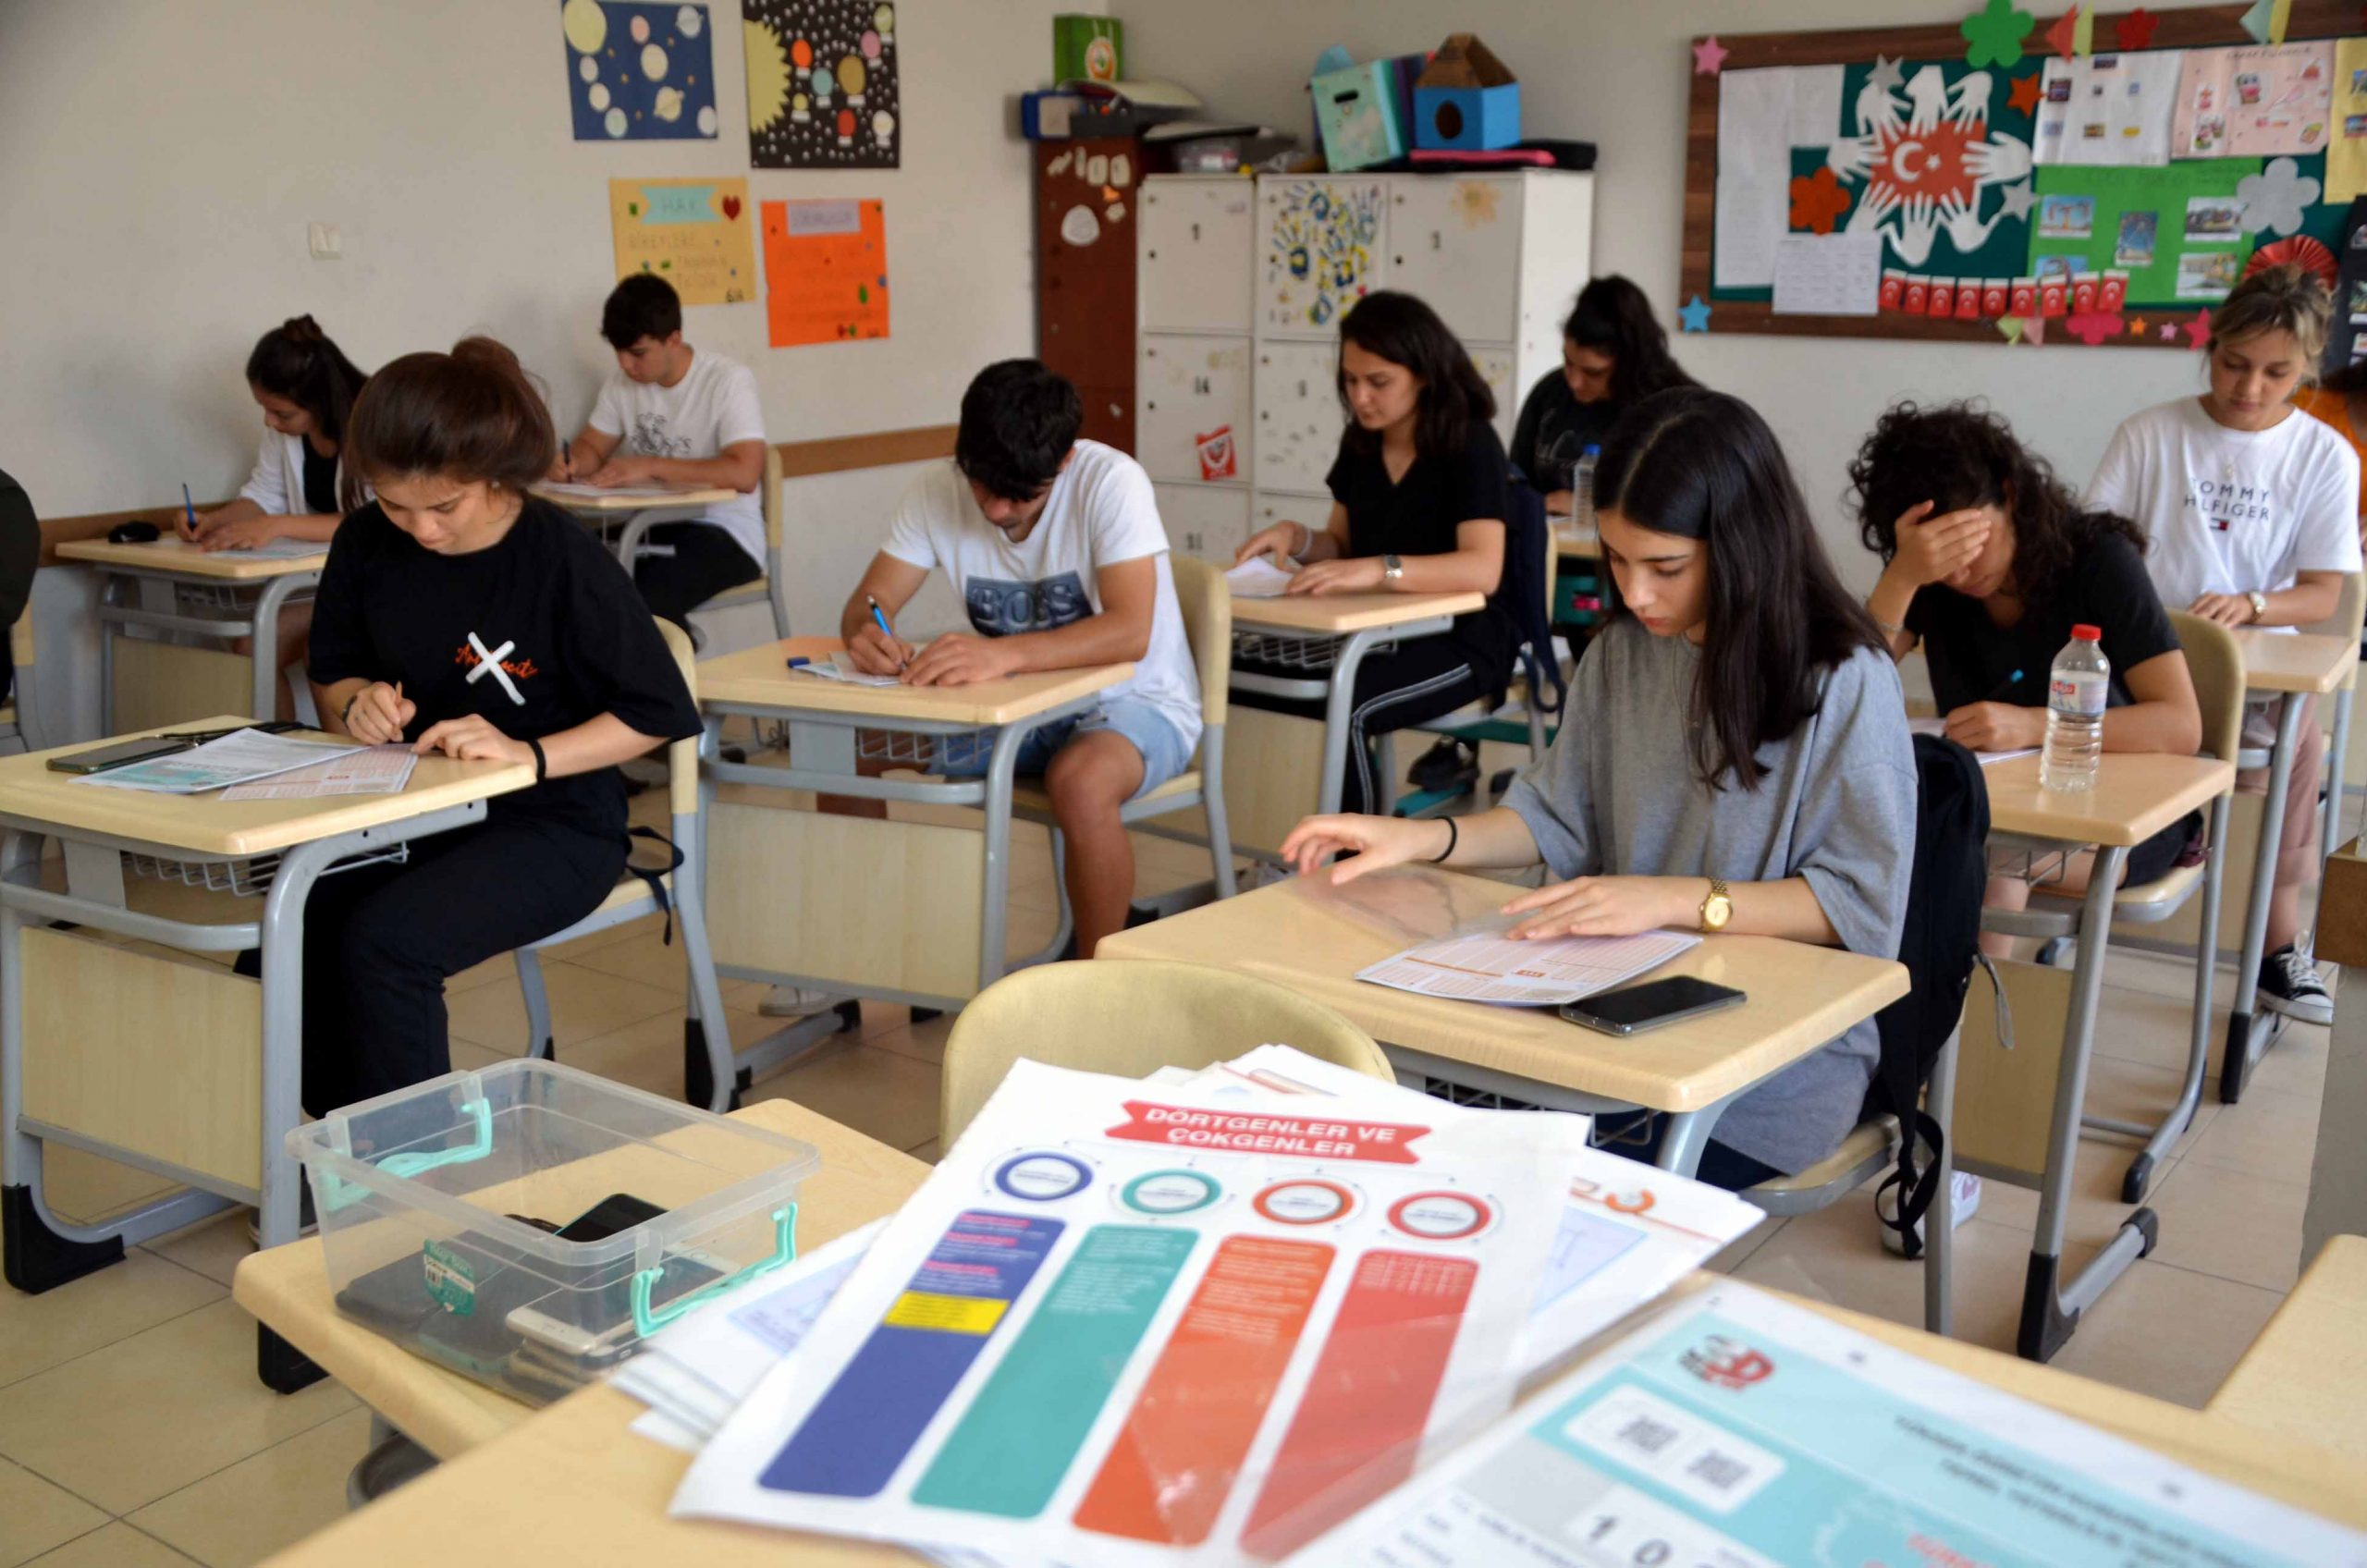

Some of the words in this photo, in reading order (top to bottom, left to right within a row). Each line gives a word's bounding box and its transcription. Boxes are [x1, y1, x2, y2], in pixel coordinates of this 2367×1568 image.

[2190, 477, 2270, 502] TOMMY
[2184, 495, 2270, 521] HLFIGER
[1145, 1108, 1348, 1140] DÖRTGENLER
[1358, 1126, 1396, 1143] VE
[1167, 1127, 1356, 1156] ÇOKGENLER
